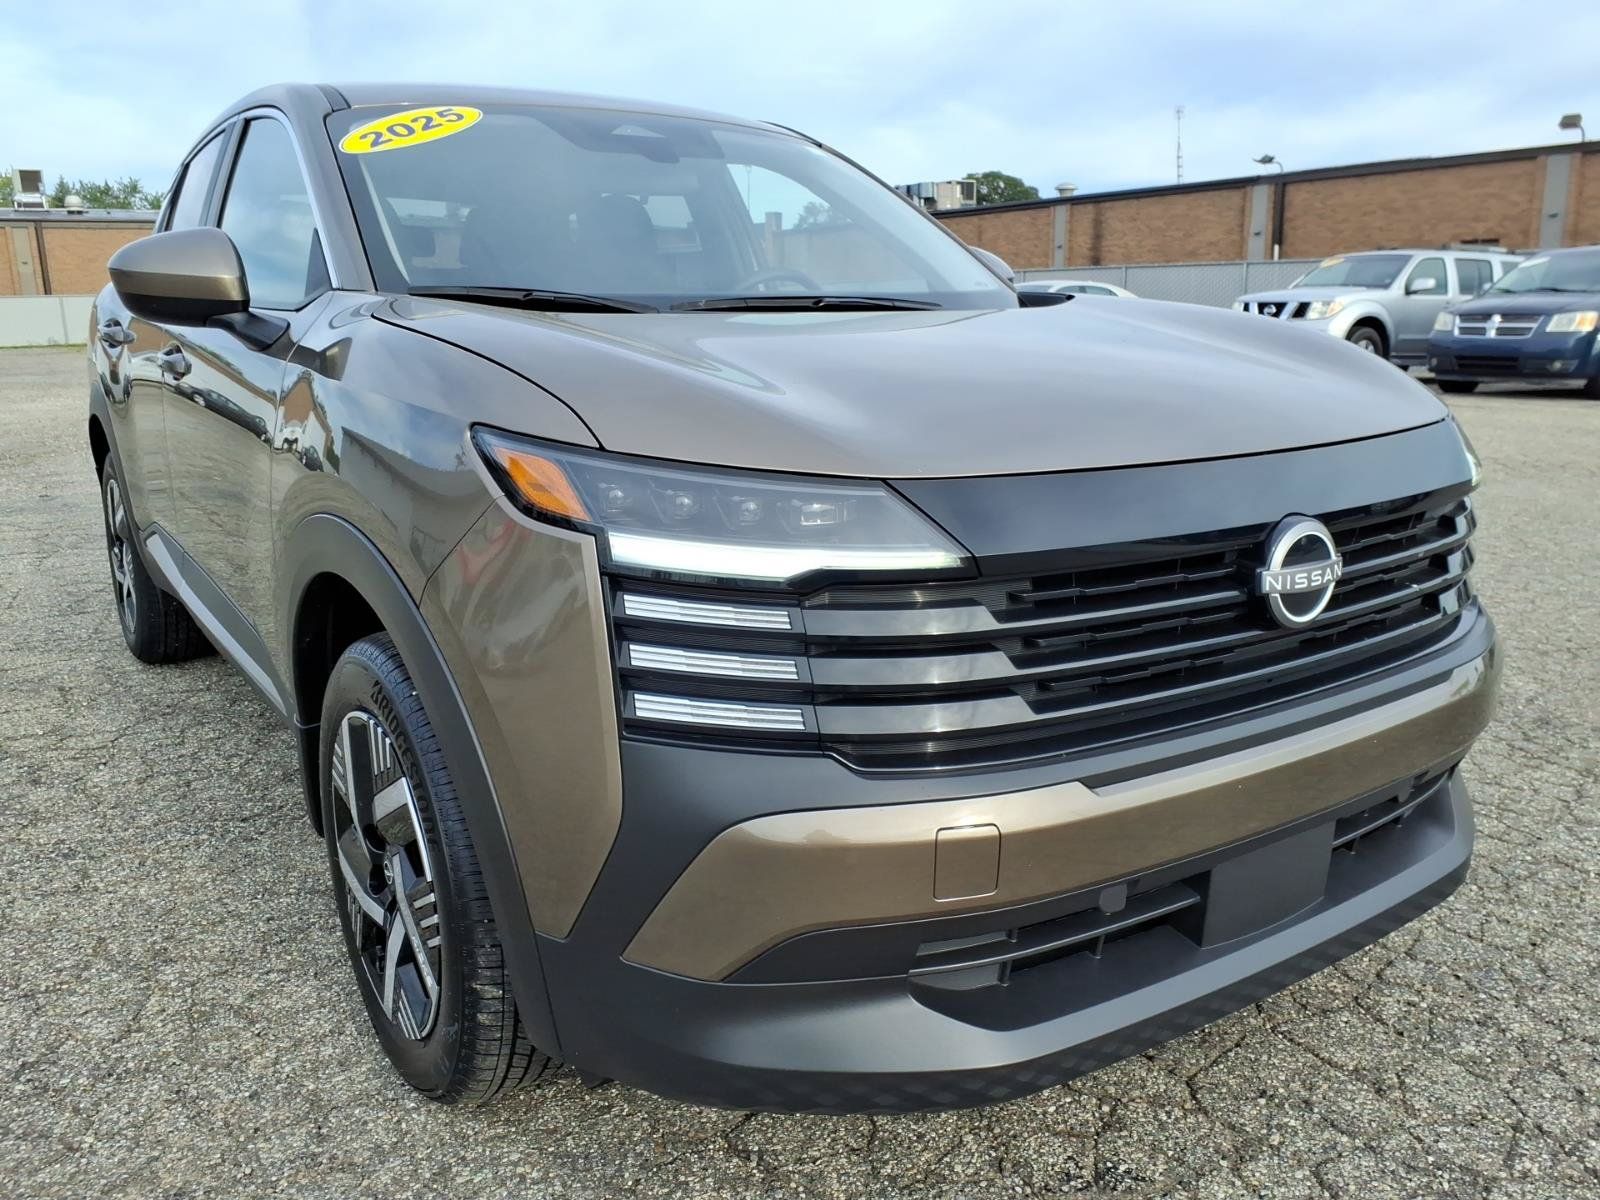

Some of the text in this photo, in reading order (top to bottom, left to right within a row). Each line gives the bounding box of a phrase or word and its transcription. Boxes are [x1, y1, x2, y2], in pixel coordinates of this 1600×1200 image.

[359, 108, 465, 148] 2025
[1266, 561, 1342, 591] NISSAN
[370, 680, 441, 850] BRIDGESTONE
